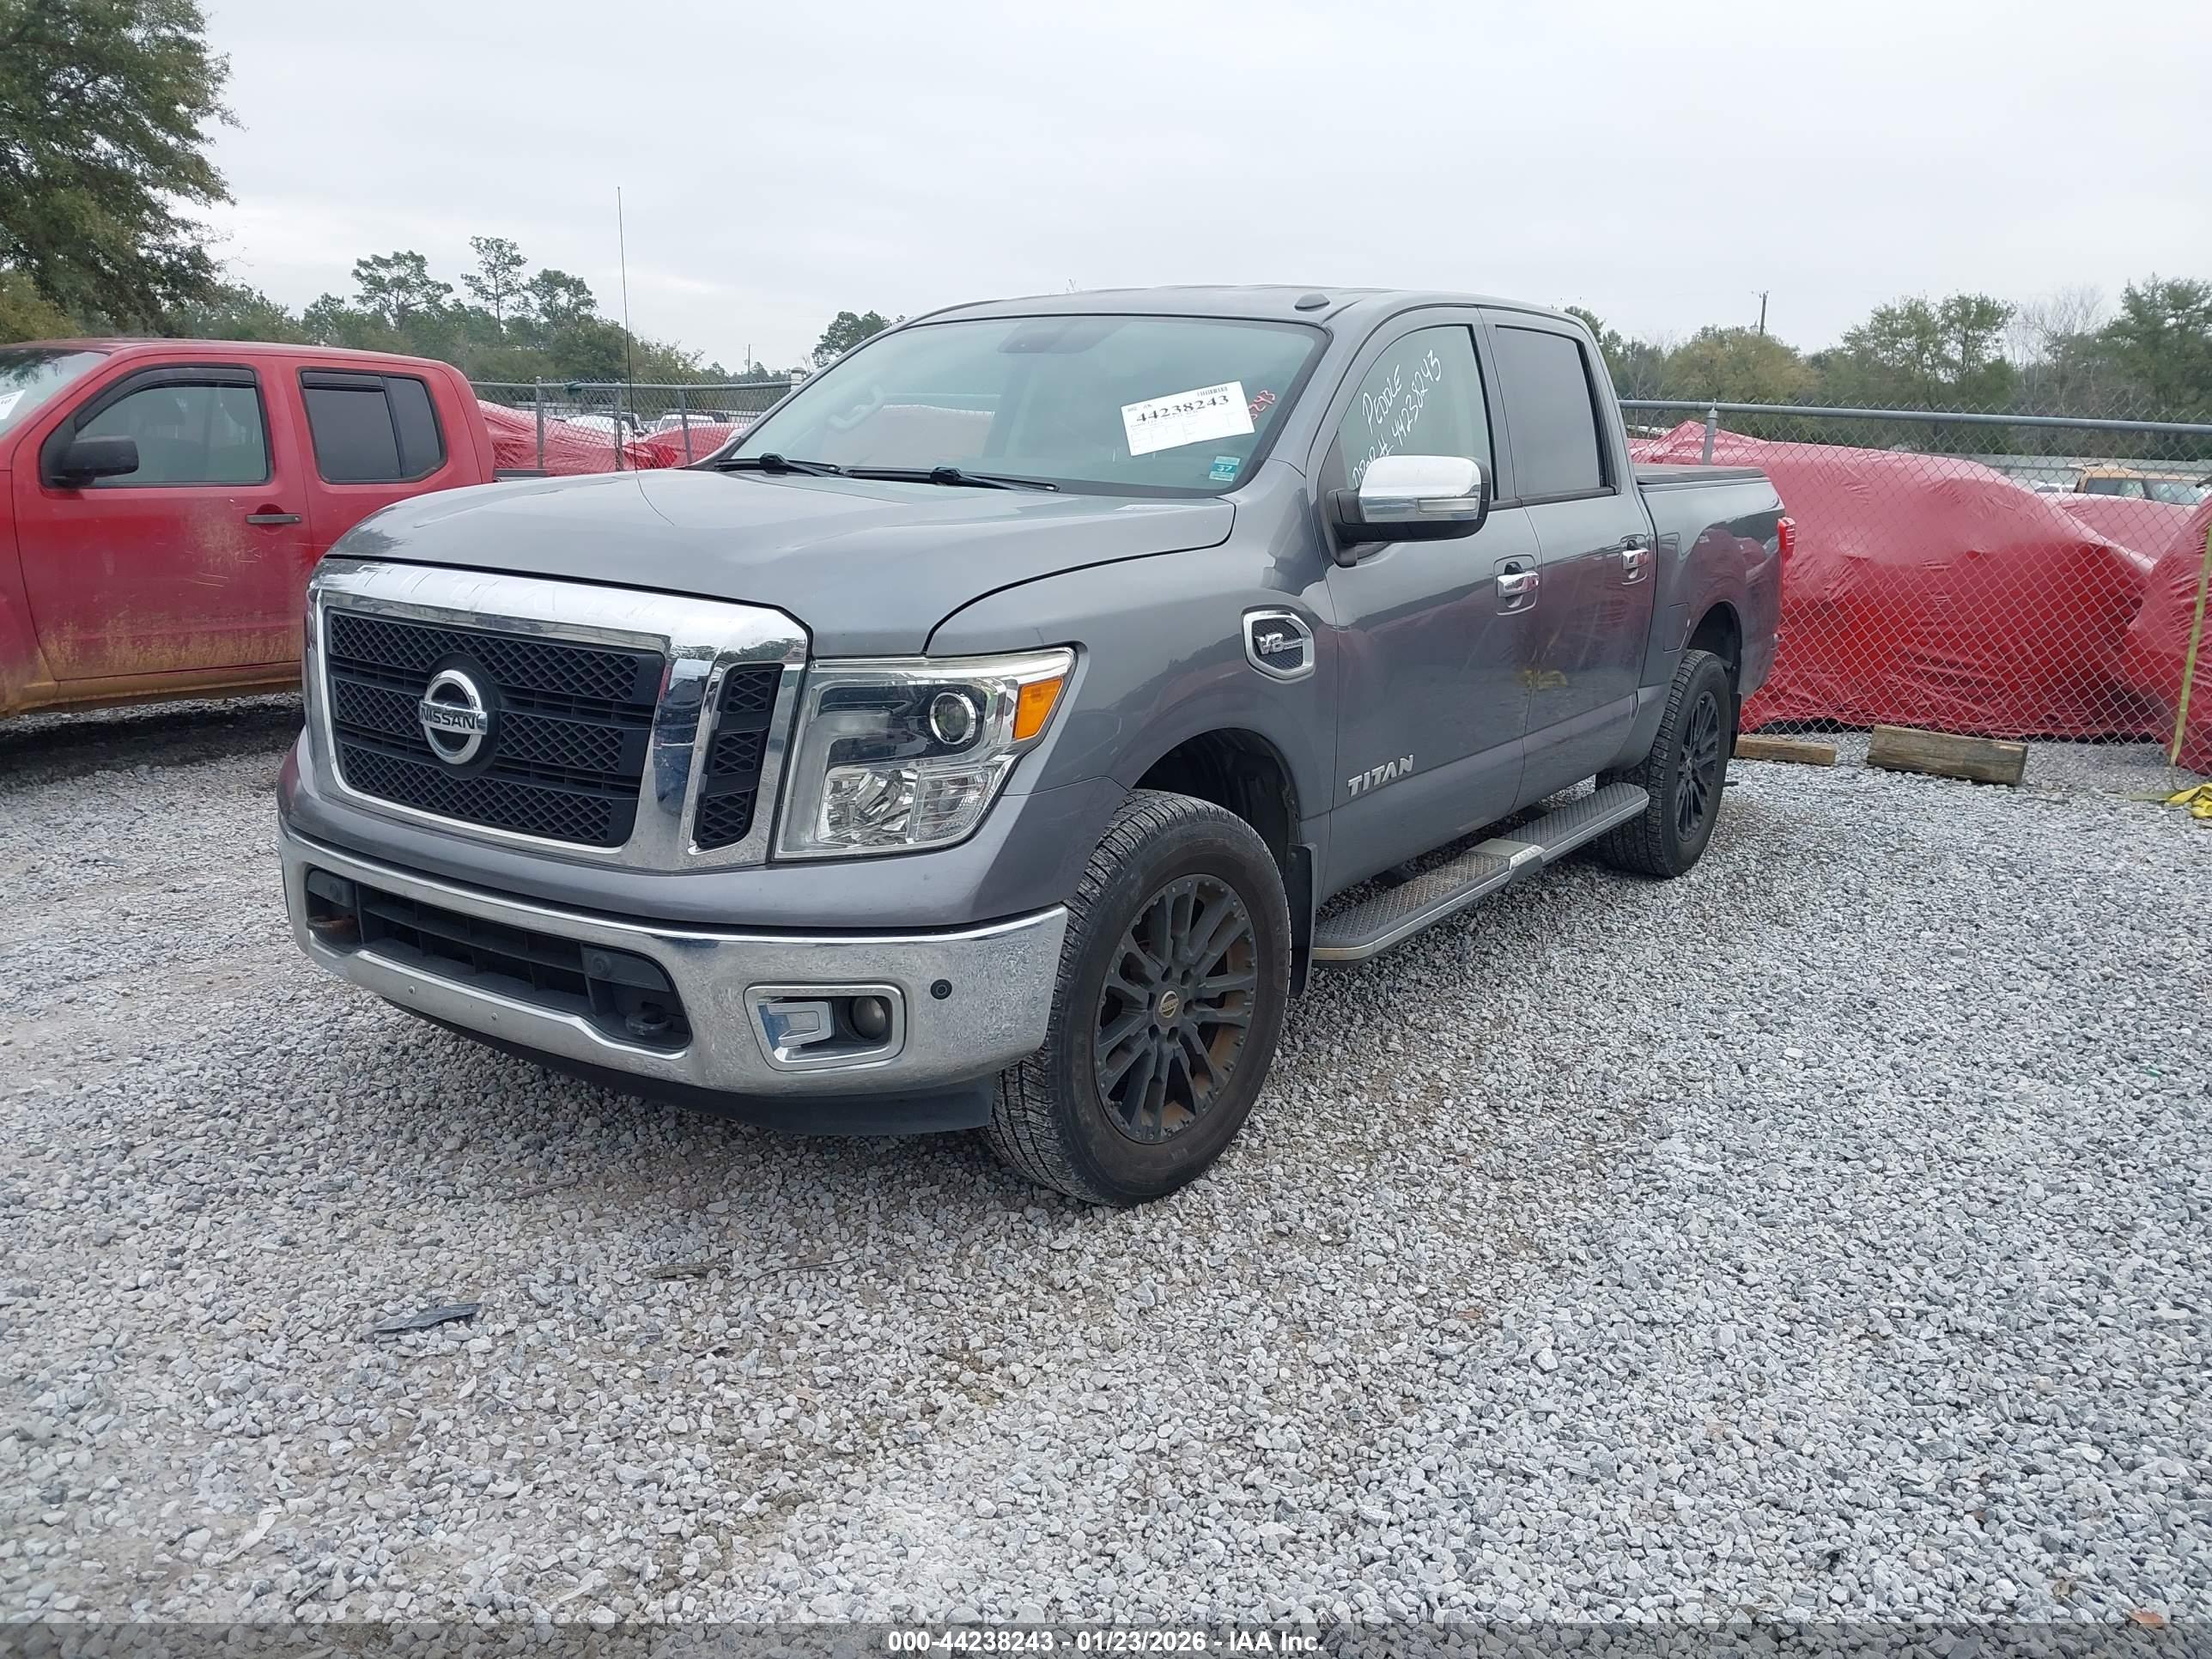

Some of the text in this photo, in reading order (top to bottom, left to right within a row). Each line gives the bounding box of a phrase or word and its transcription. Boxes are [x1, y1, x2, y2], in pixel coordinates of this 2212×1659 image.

[1136, 395, 1230, 422] 44238243
[1391, 349, 1442, 447] 44238243
[1255, 632, 1284, 654] V8
[421, 707, 475, 730] NISSAN
[1347, 754, 1414, 797] TITAN
